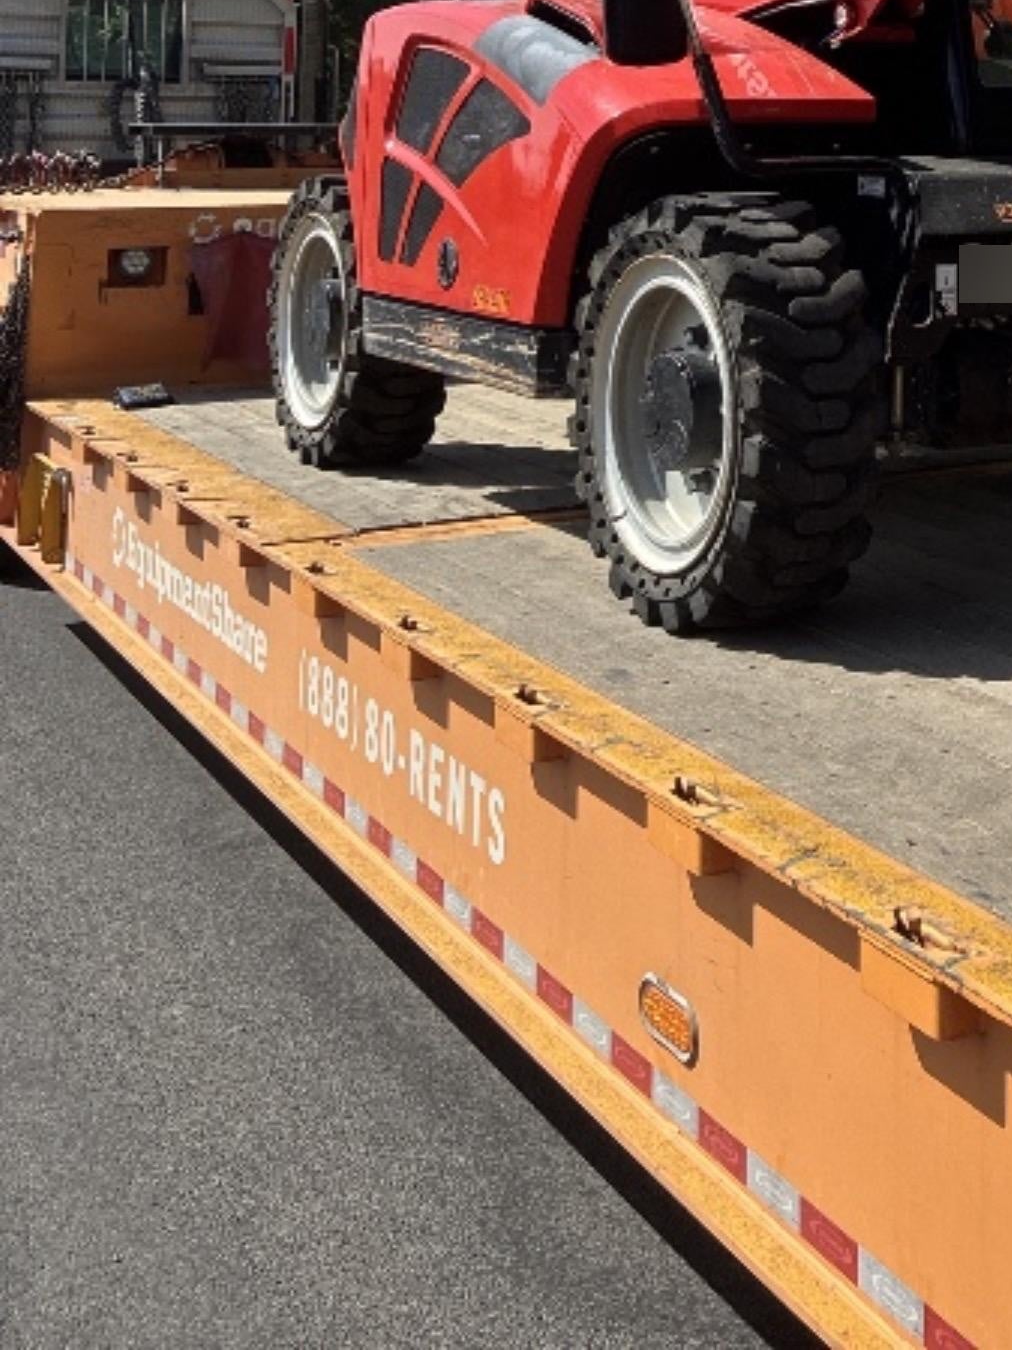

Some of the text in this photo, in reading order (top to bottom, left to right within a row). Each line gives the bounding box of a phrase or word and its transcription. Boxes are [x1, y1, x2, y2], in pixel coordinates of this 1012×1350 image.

[126, 521, 269, 674] EquipmentShare
[299, 648, 505, 865] (888) 80-RENTS
